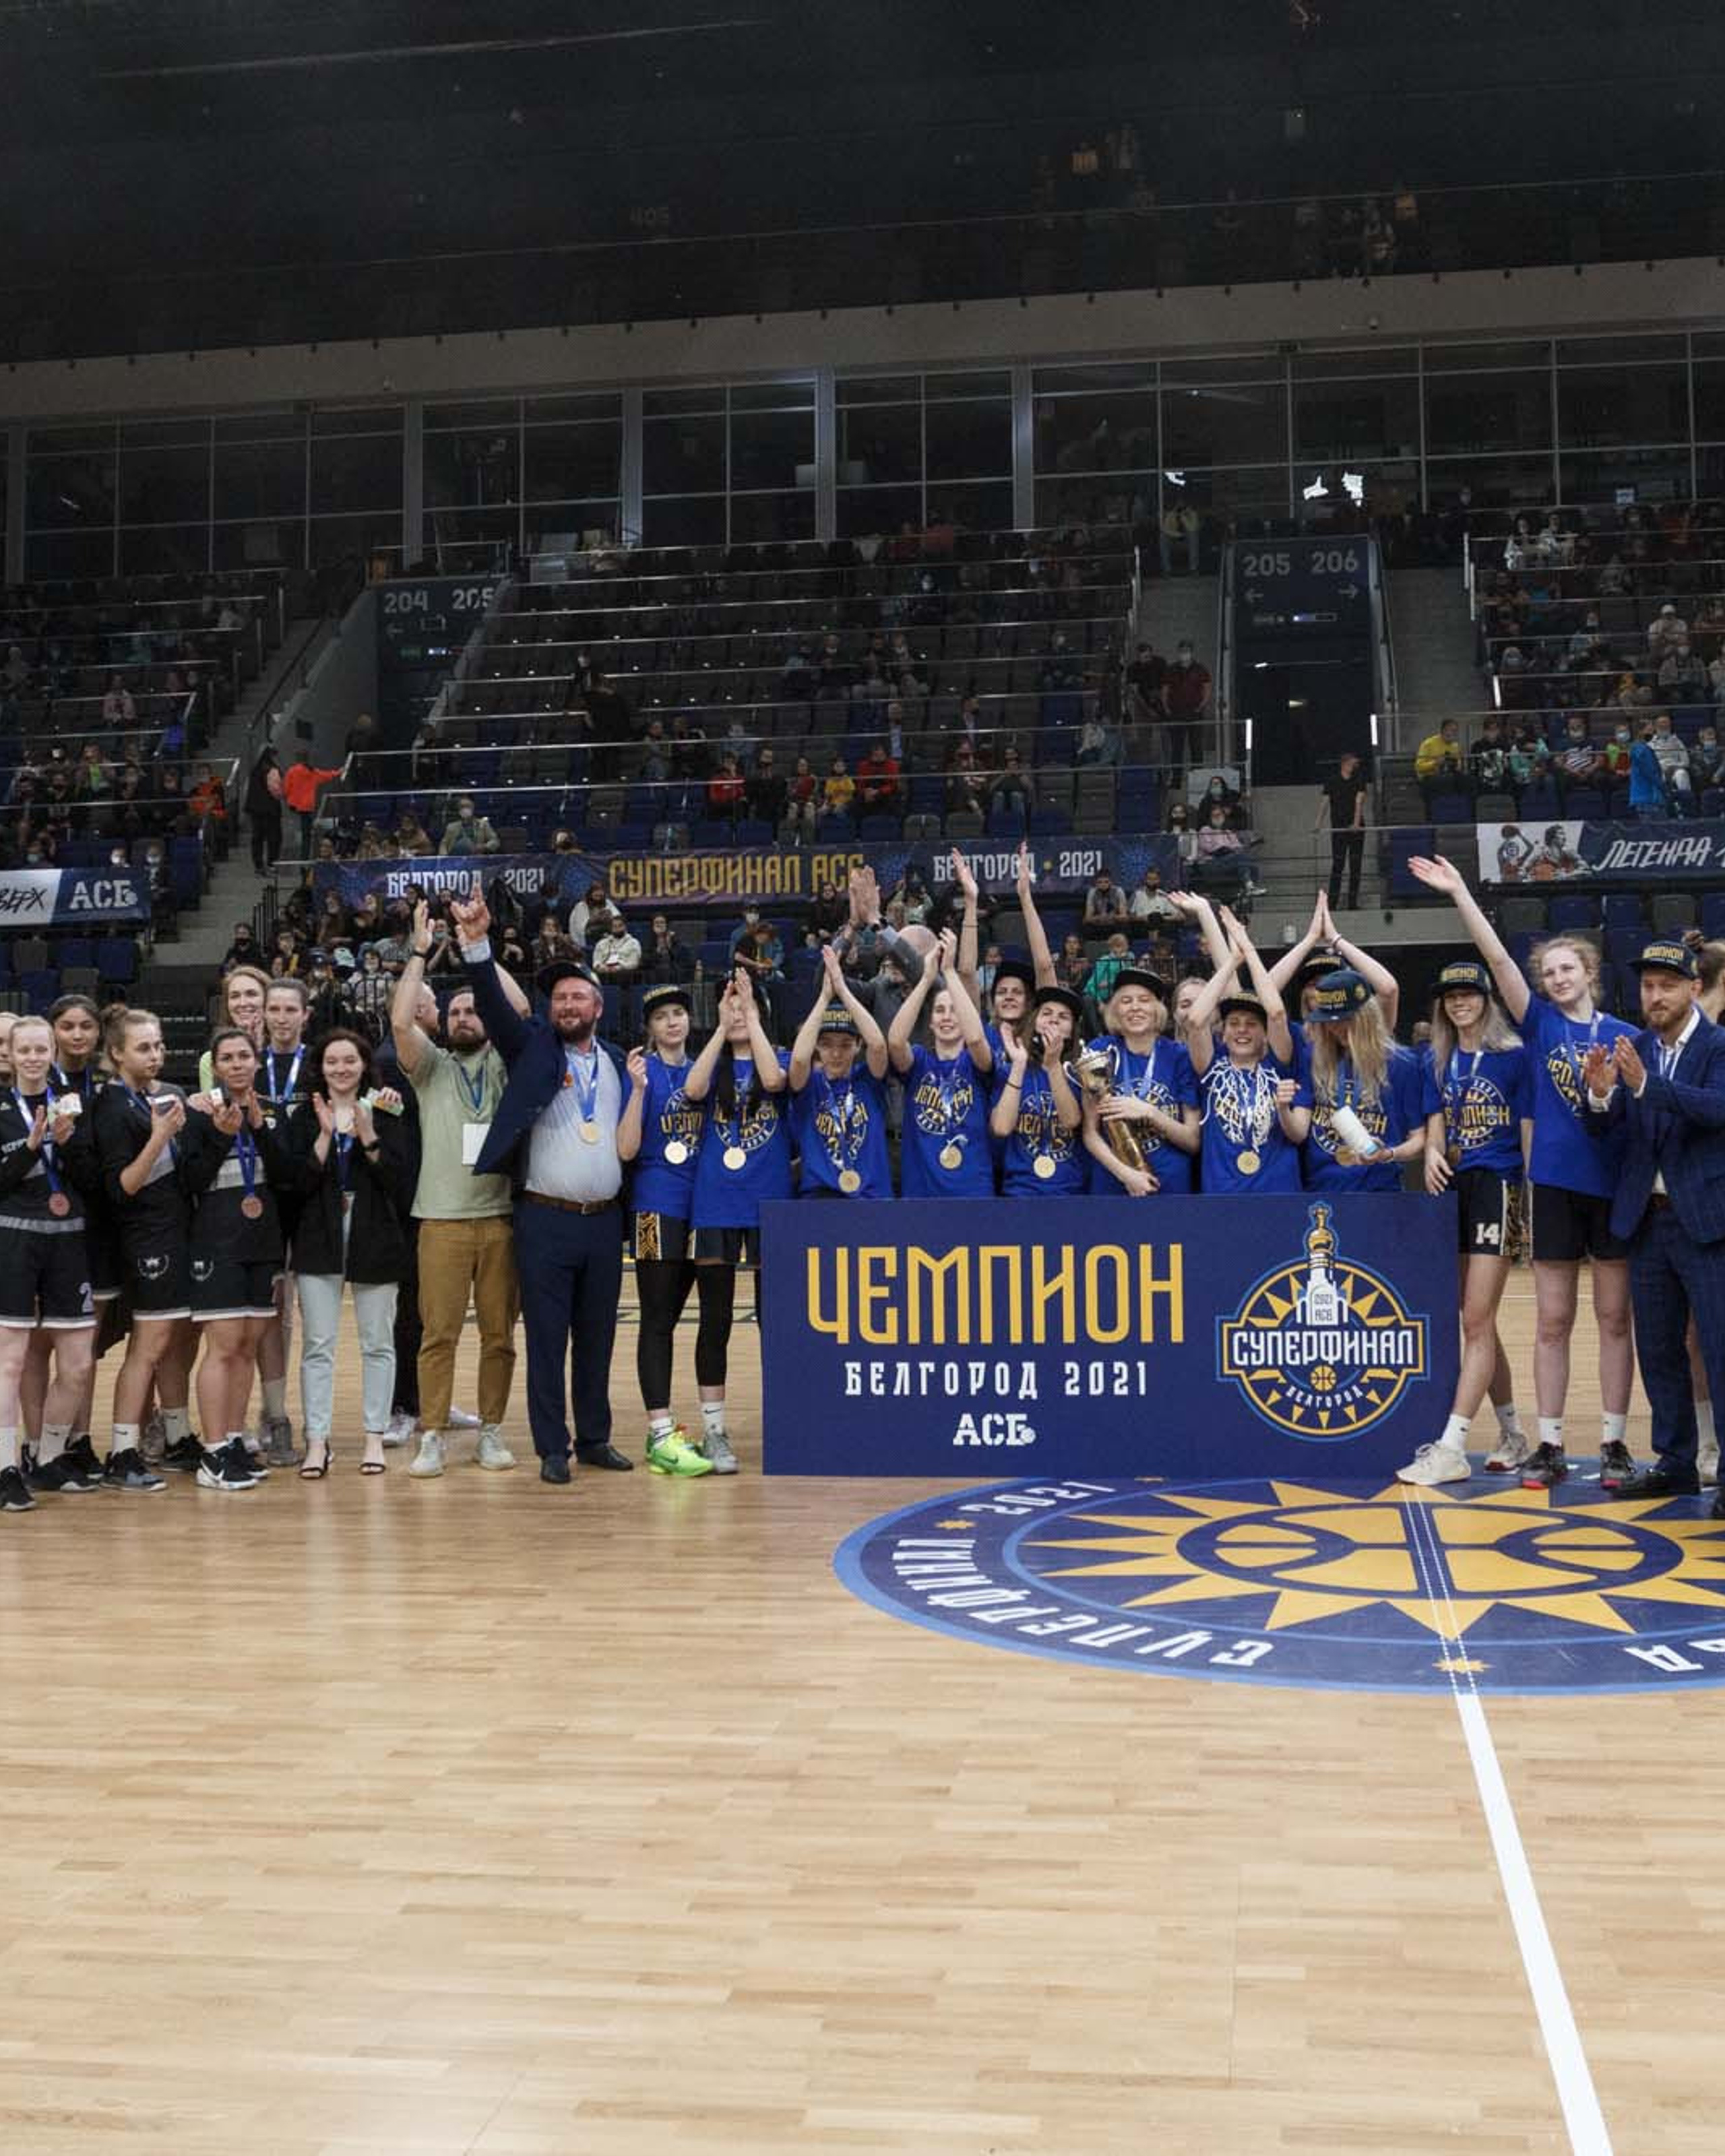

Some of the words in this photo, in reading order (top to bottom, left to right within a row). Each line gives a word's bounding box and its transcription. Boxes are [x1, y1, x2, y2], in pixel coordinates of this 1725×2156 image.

[1243, 553, 1290, 577] 205
[1311, 548, 1359, 573] 206
[383, 590, 429, 614] 204
[933, 853, 1036, 882] БЕГОРО
[1059, 850, 1102, 877] 2021
[1592, 837, 1713, 871] ЛЕГЕНДА
[505, 867, 544, 893] 2021
[610, 854, 801, 899] СУПЕРФИНАЛ
[69, 879, 138, 909] АСБ
[1476, 1223, 1499, 1246] 14
[807, 1243, 1184, 1343] ЧЕМПИОН
[1232, 1330, 1414, 1366] СУПЕРФИНАЛ
[845, 1361, 1038, 1399] БЕЛГОРОД
[1065, 1361, 1146, 1396] 2021
[953, 1413, 1036, 1446] АСБ
[958, 1481, 1117, 1515] 2021
[891, 1538, 1274, 1666] СУПЕРФИНАЛ
